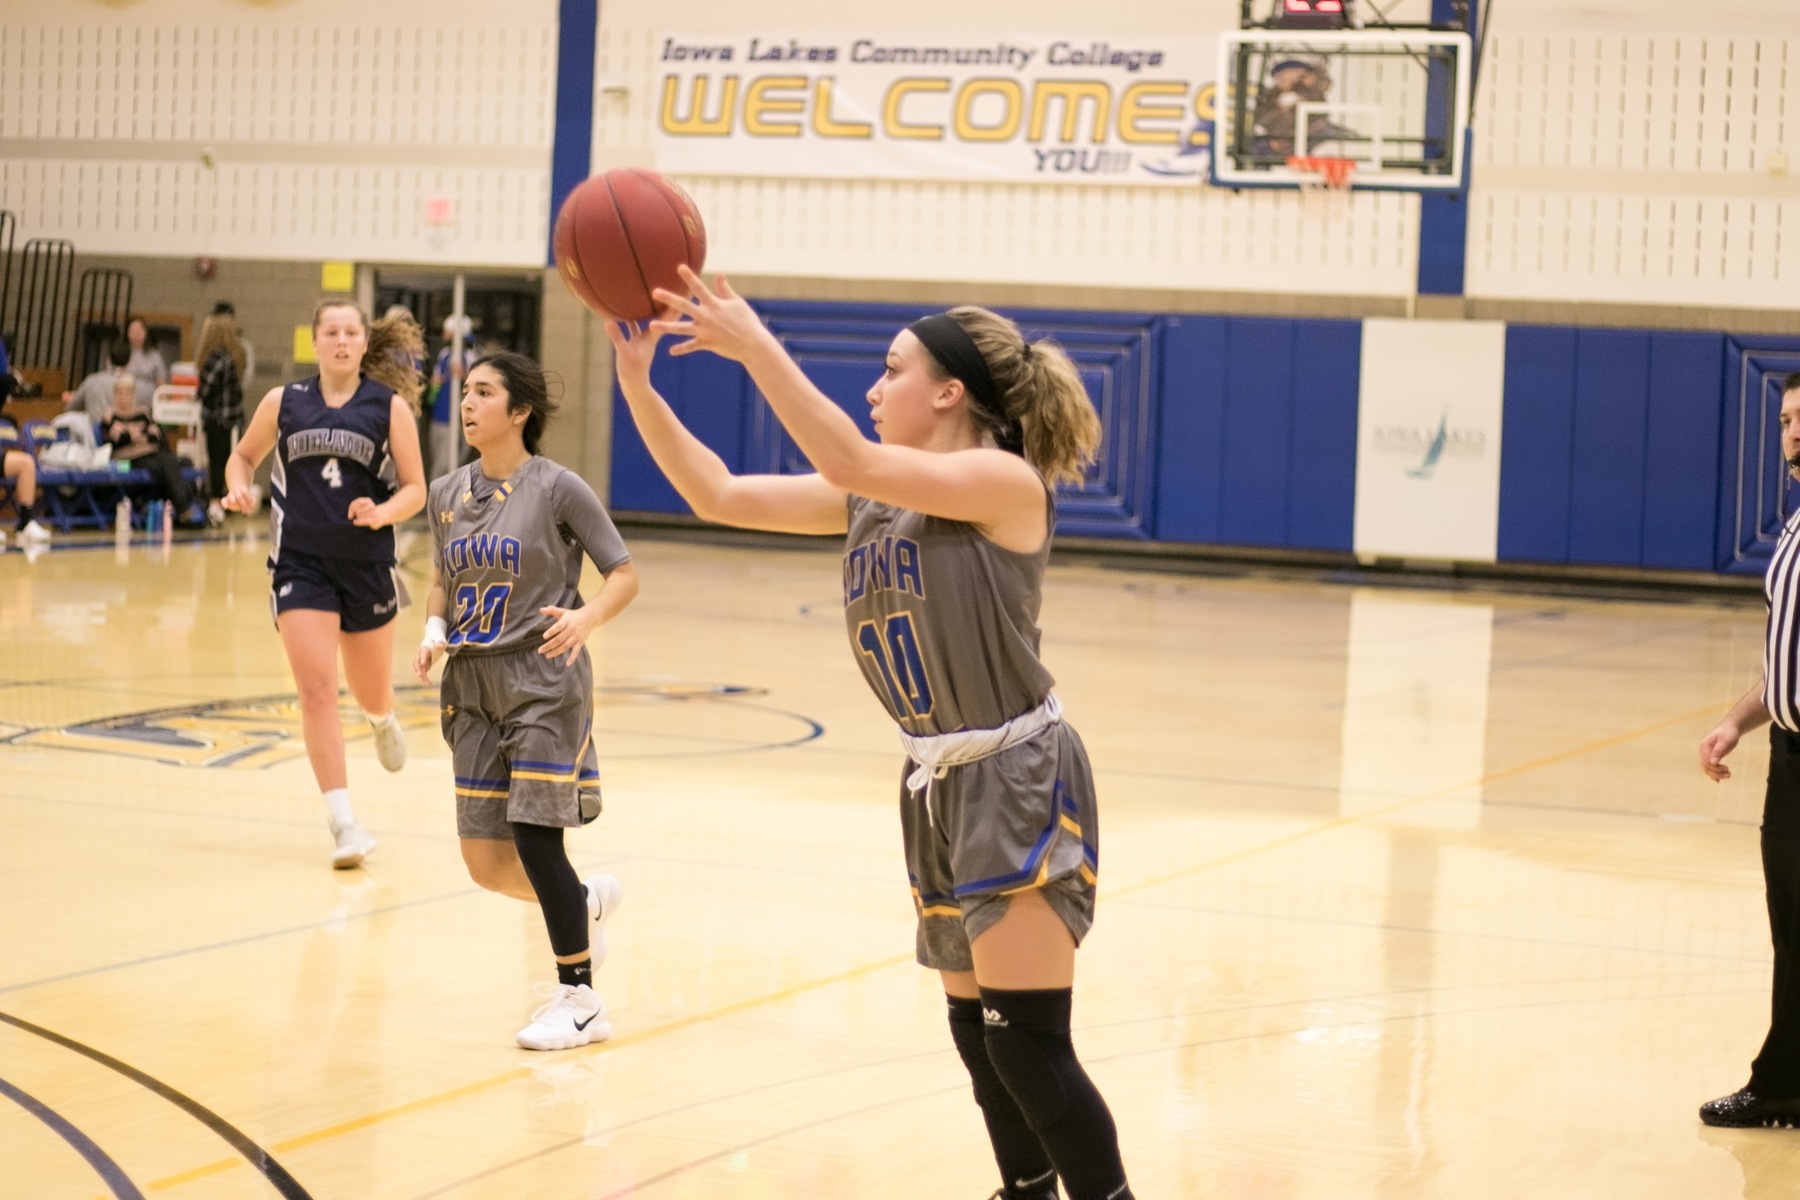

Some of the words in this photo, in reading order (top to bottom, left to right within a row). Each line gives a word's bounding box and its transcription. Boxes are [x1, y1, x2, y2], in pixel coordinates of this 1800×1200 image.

[661, 39, 735, 63] Iowa
[748, 39, 838, 63] Lakes
[850, 40, 1036, 70] Community
[1046, 43, 1164, 71] College
[321, 457, 342, 488] 4
[443, 532, 522, 580] IOWA
[447, 582, 514, 647] 20
[856, 610, 935, 721] 10
